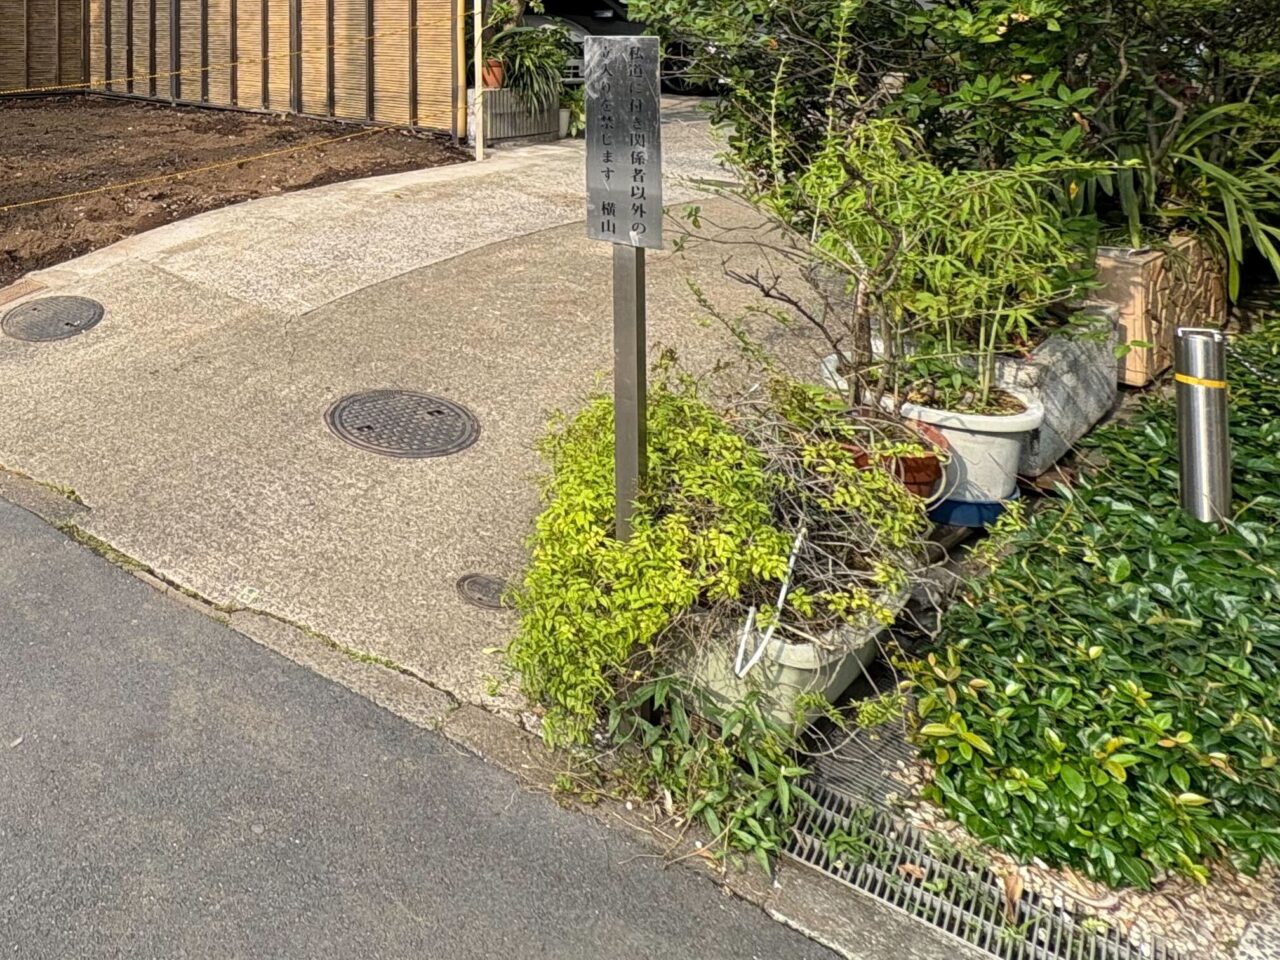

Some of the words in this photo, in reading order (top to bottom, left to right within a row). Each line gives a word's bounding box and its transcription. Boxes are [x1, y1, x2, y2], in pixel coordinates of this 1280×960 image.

[600, 46, 615, 181] 立入りを禁じます
[629, 45, 647, 235] 私道に付き関係者以外の
[600, 200, 617, 235] 横山
